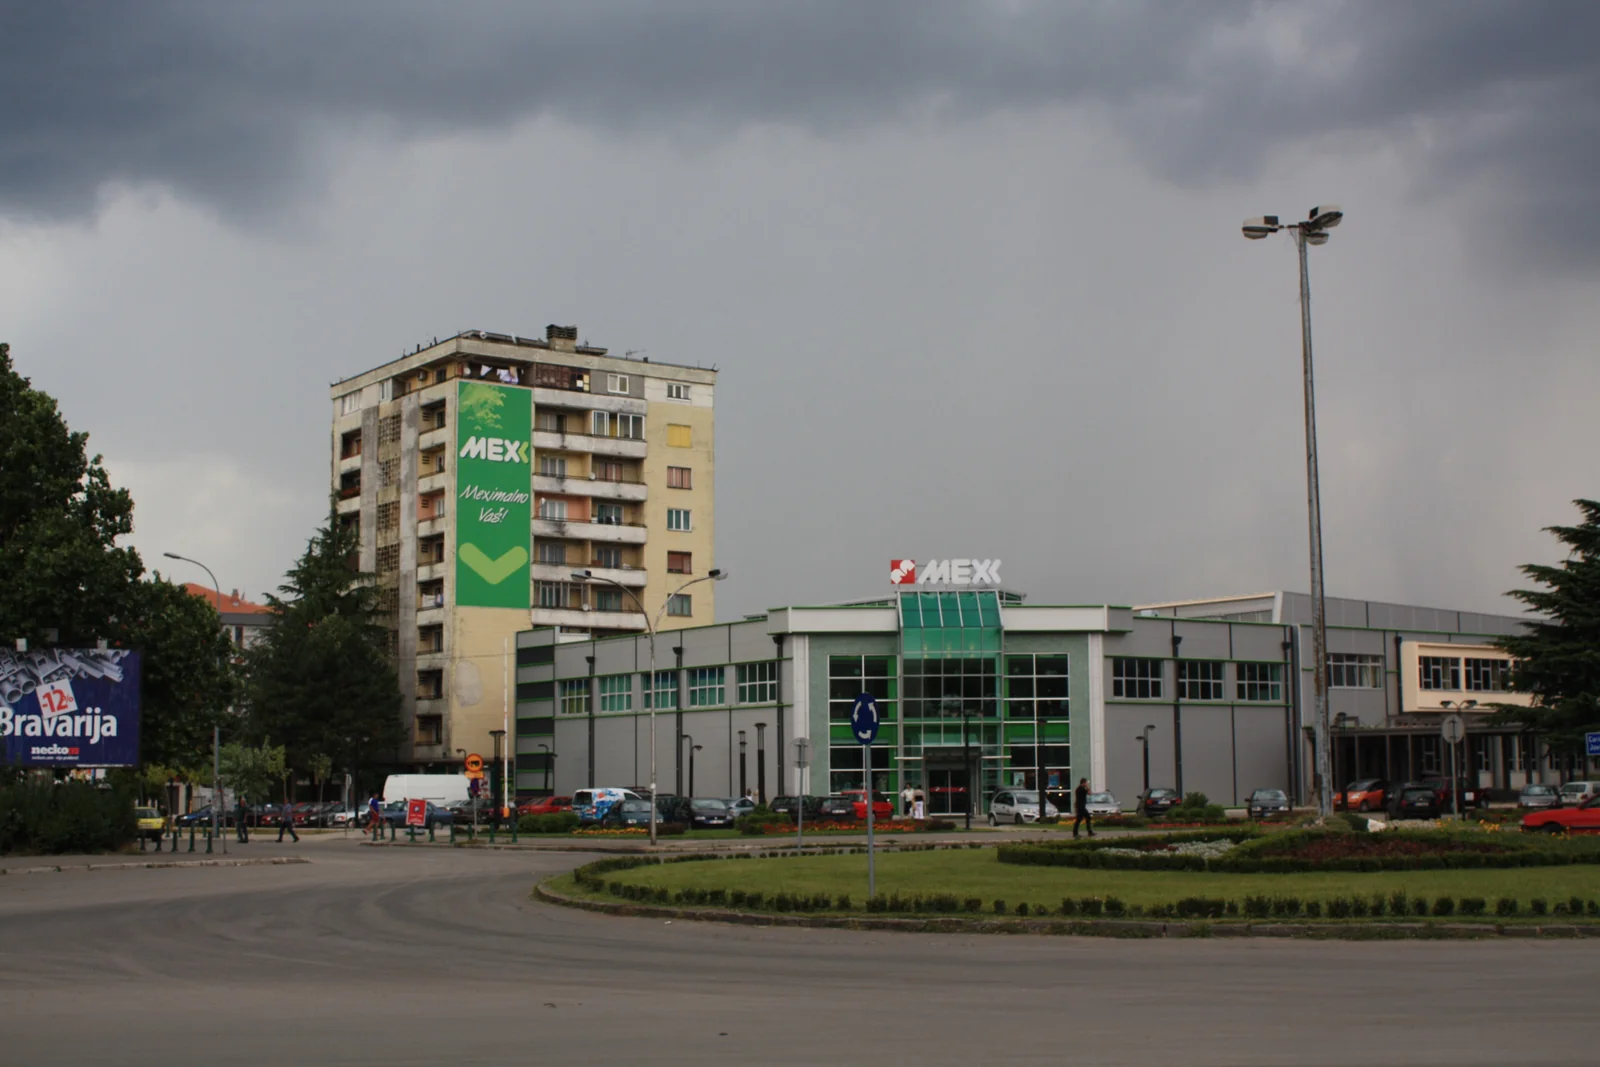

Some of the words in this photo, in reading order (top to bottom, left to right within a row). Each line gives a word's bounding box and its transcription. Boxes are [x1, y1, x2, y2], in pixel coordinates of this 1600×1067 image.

[460, 484, 529, 504] Meximalno
[479, 507, 508, 523] Vaš!
[42, 688, 74, 713] -12%
[0, 706, 117, 744] Bravarija
